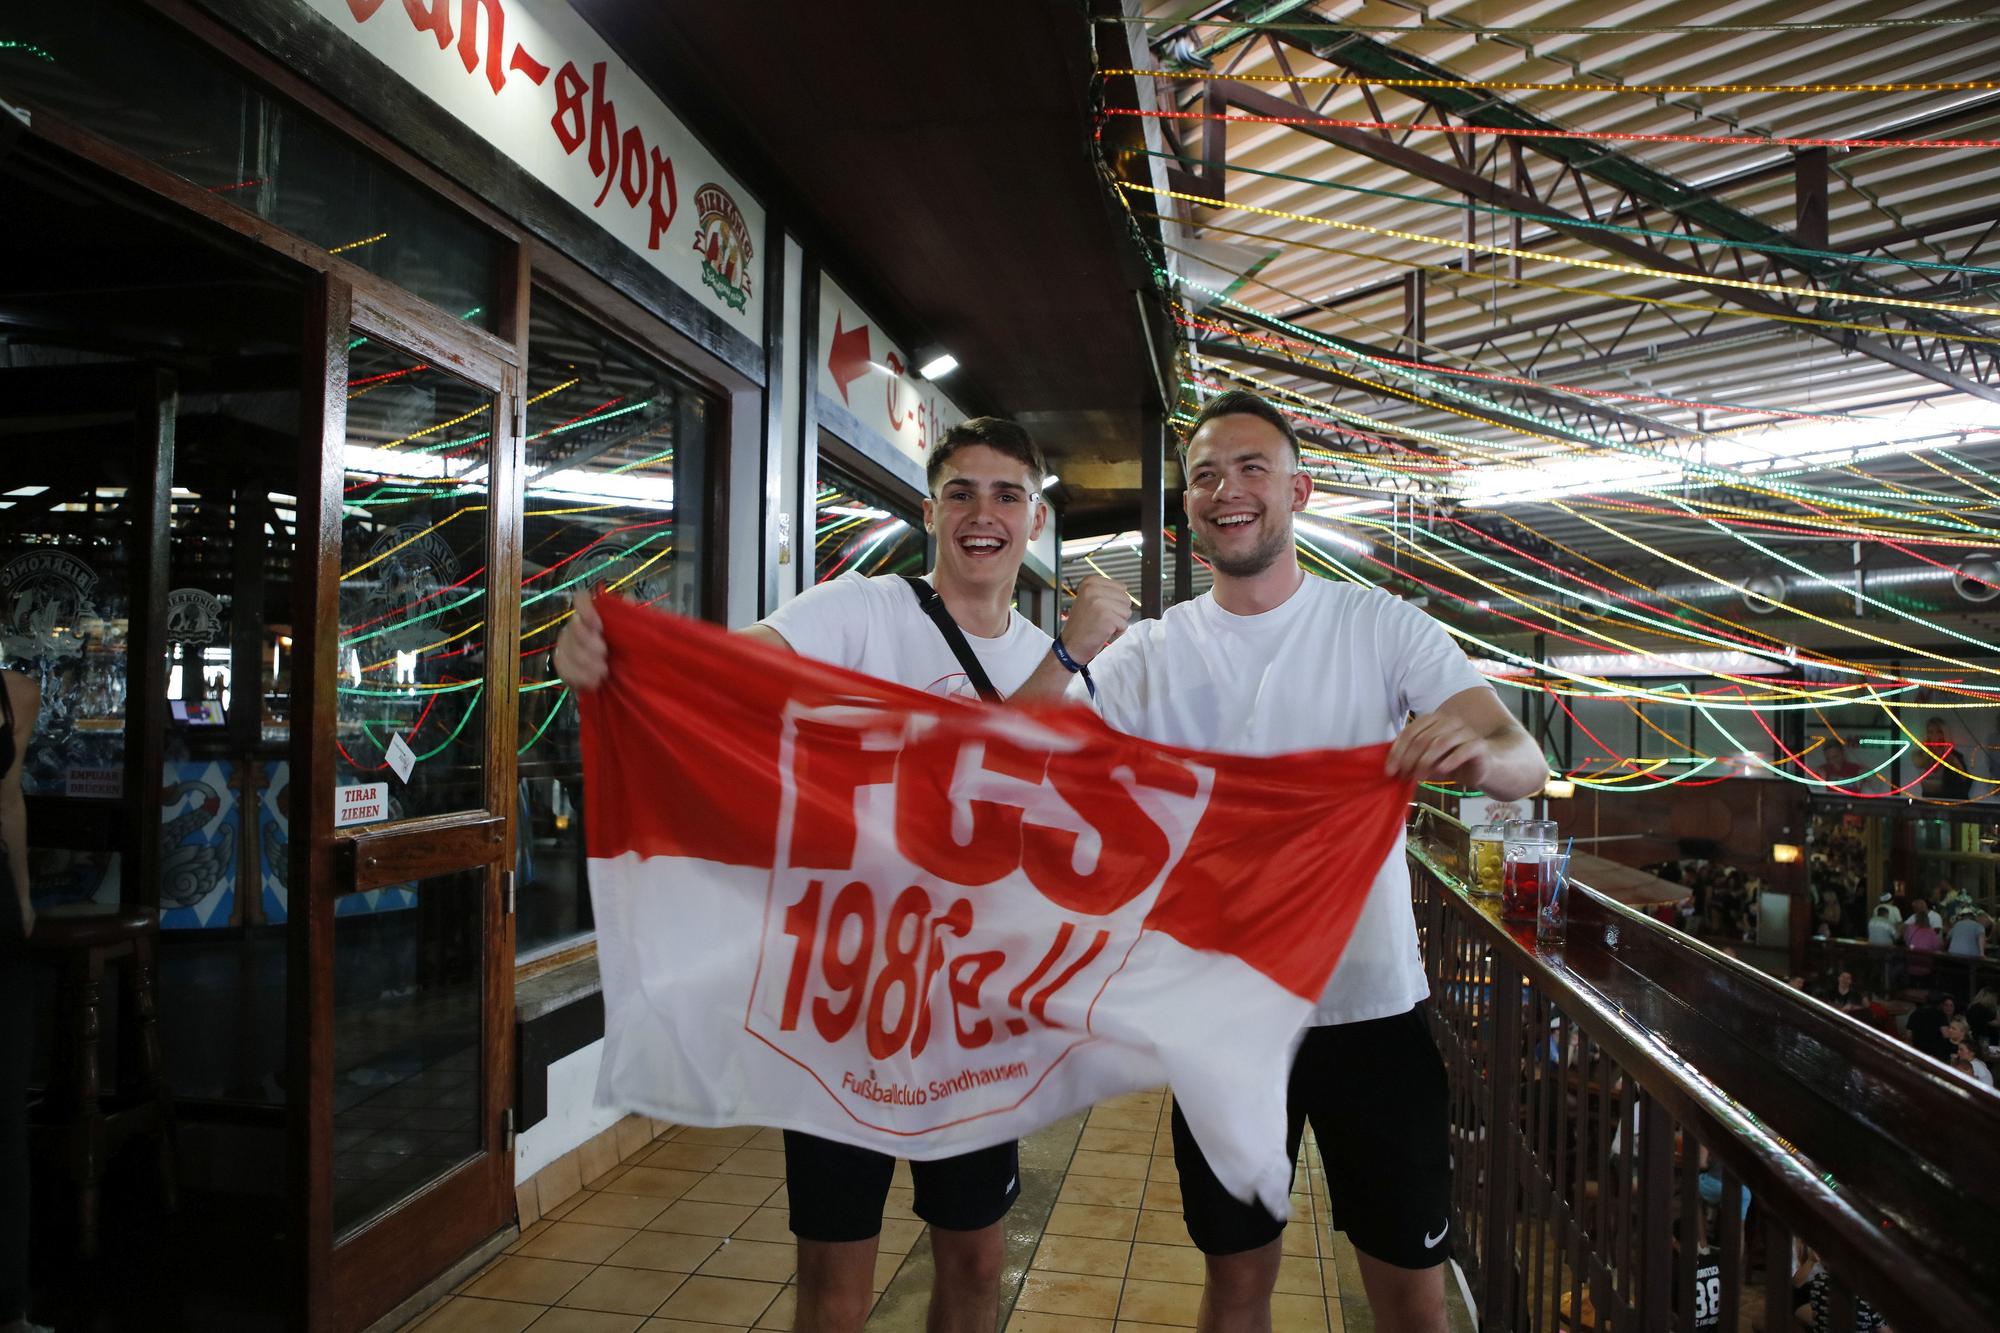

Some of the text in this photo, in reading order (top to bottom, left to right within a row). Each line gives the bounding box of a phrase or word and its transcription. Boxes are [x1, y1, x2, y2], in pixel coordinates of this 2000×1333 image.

[344, 0, 677, 250] an-shop
[345, 788, 377, 803] TIRAR
[341, 804, 380, 821] ZIEHEN
[842, 1061, 1027, 1106] Fußballclub Sandhausen
